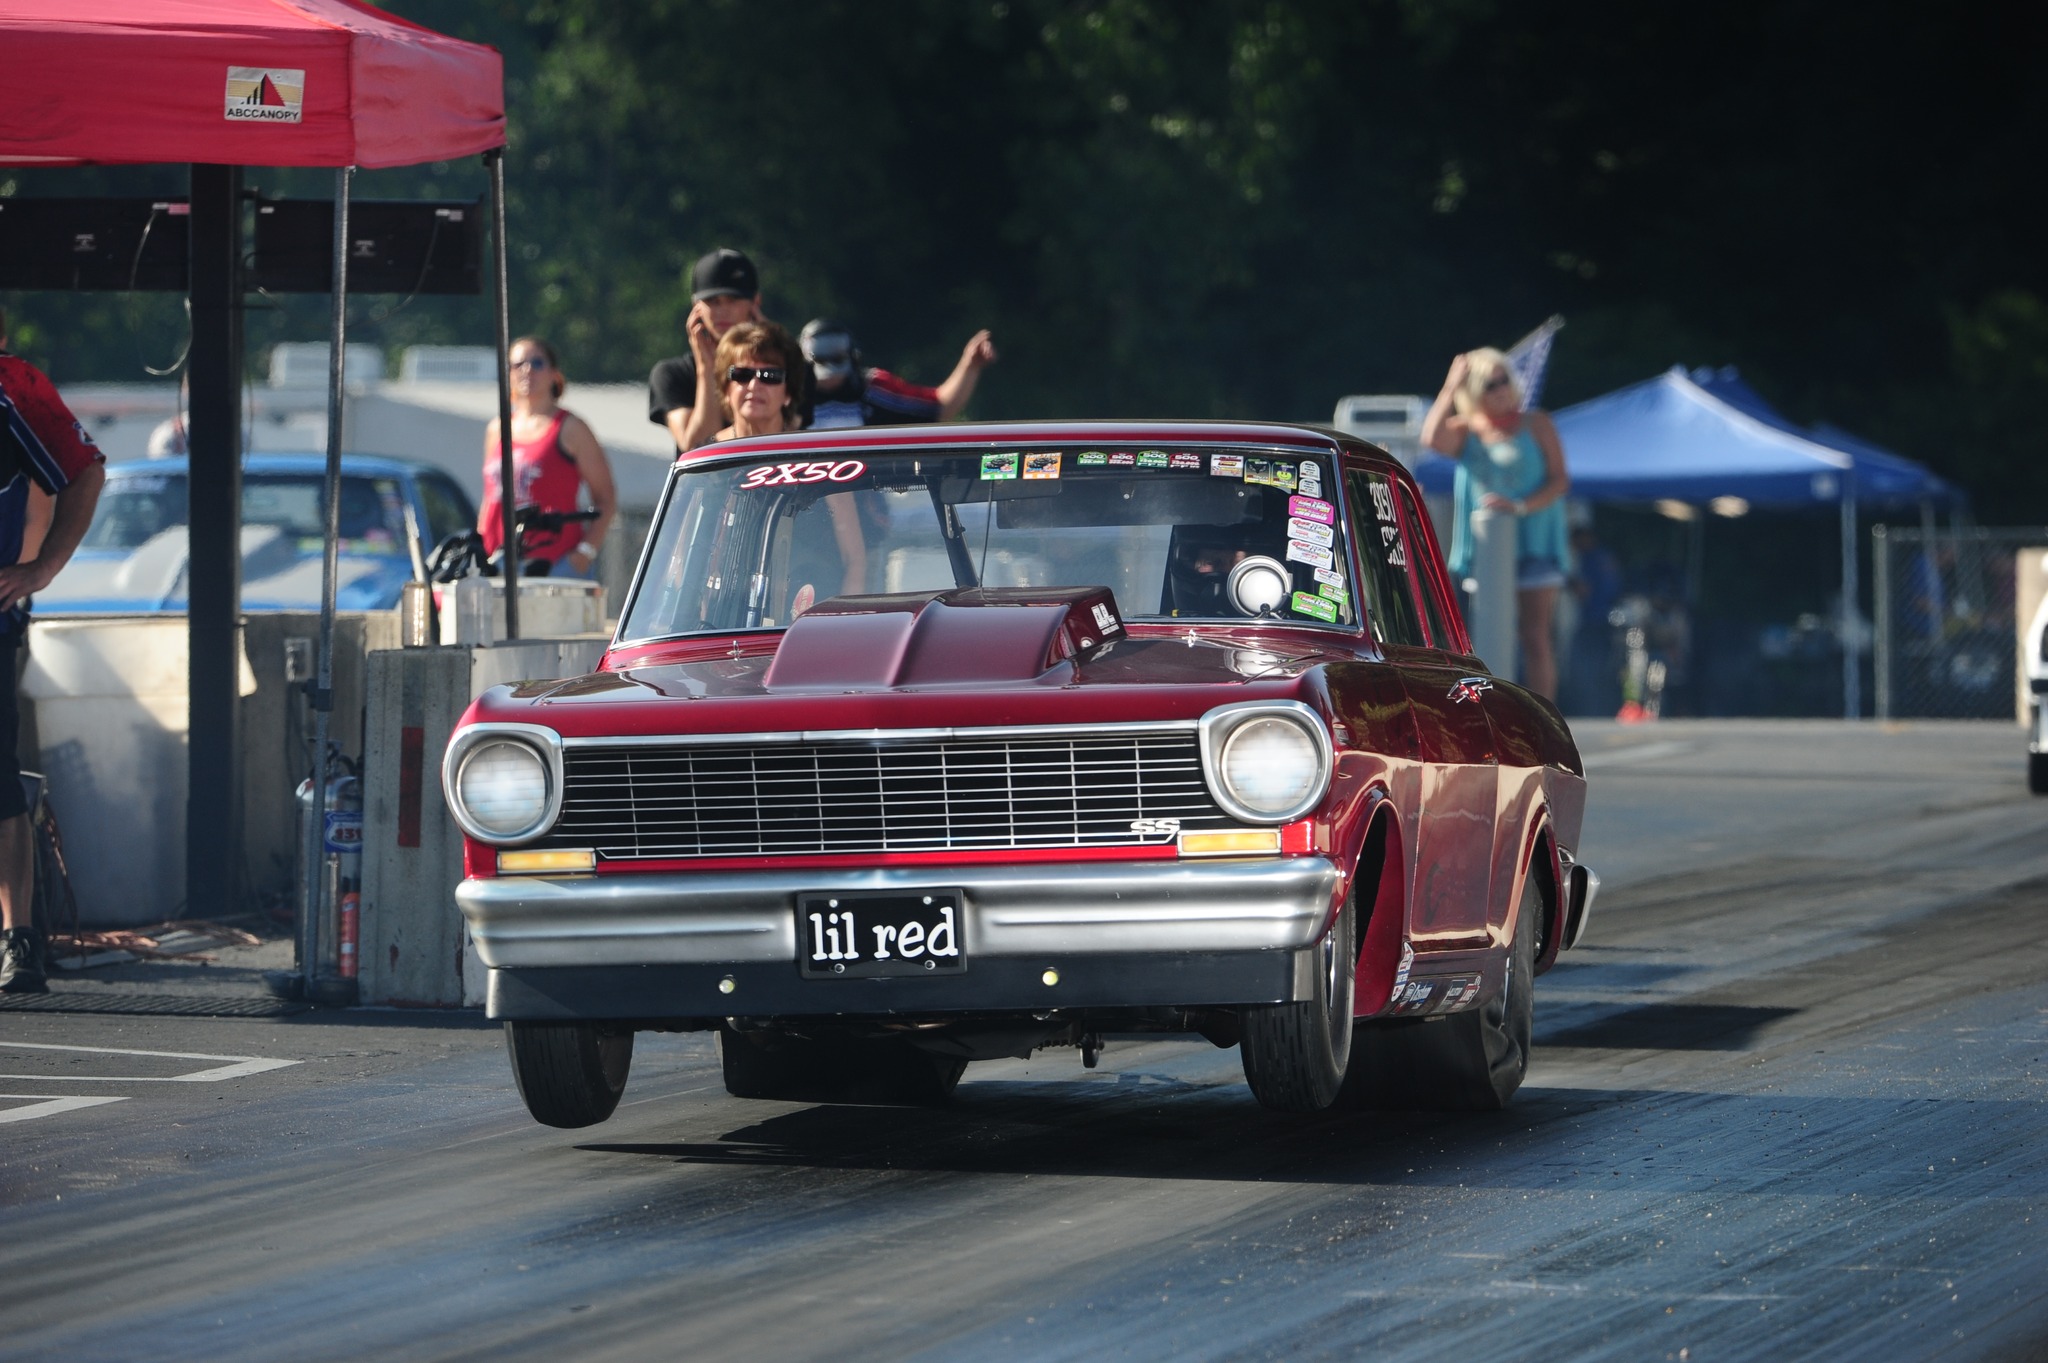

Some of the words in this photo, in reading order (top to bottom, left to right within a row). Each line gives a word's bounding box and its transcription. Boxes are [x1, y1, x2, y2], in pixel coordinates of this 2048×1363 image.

[227, 108, 299, 120] ABCCANOPY
[740, 460, 866, 489] 3X50
[1369, 482, 1397, 523] 3X50
[1130, 819, 1180, 834] SS
[809, 912, 859, 961] lil
[871, 906, 959, 959] red
